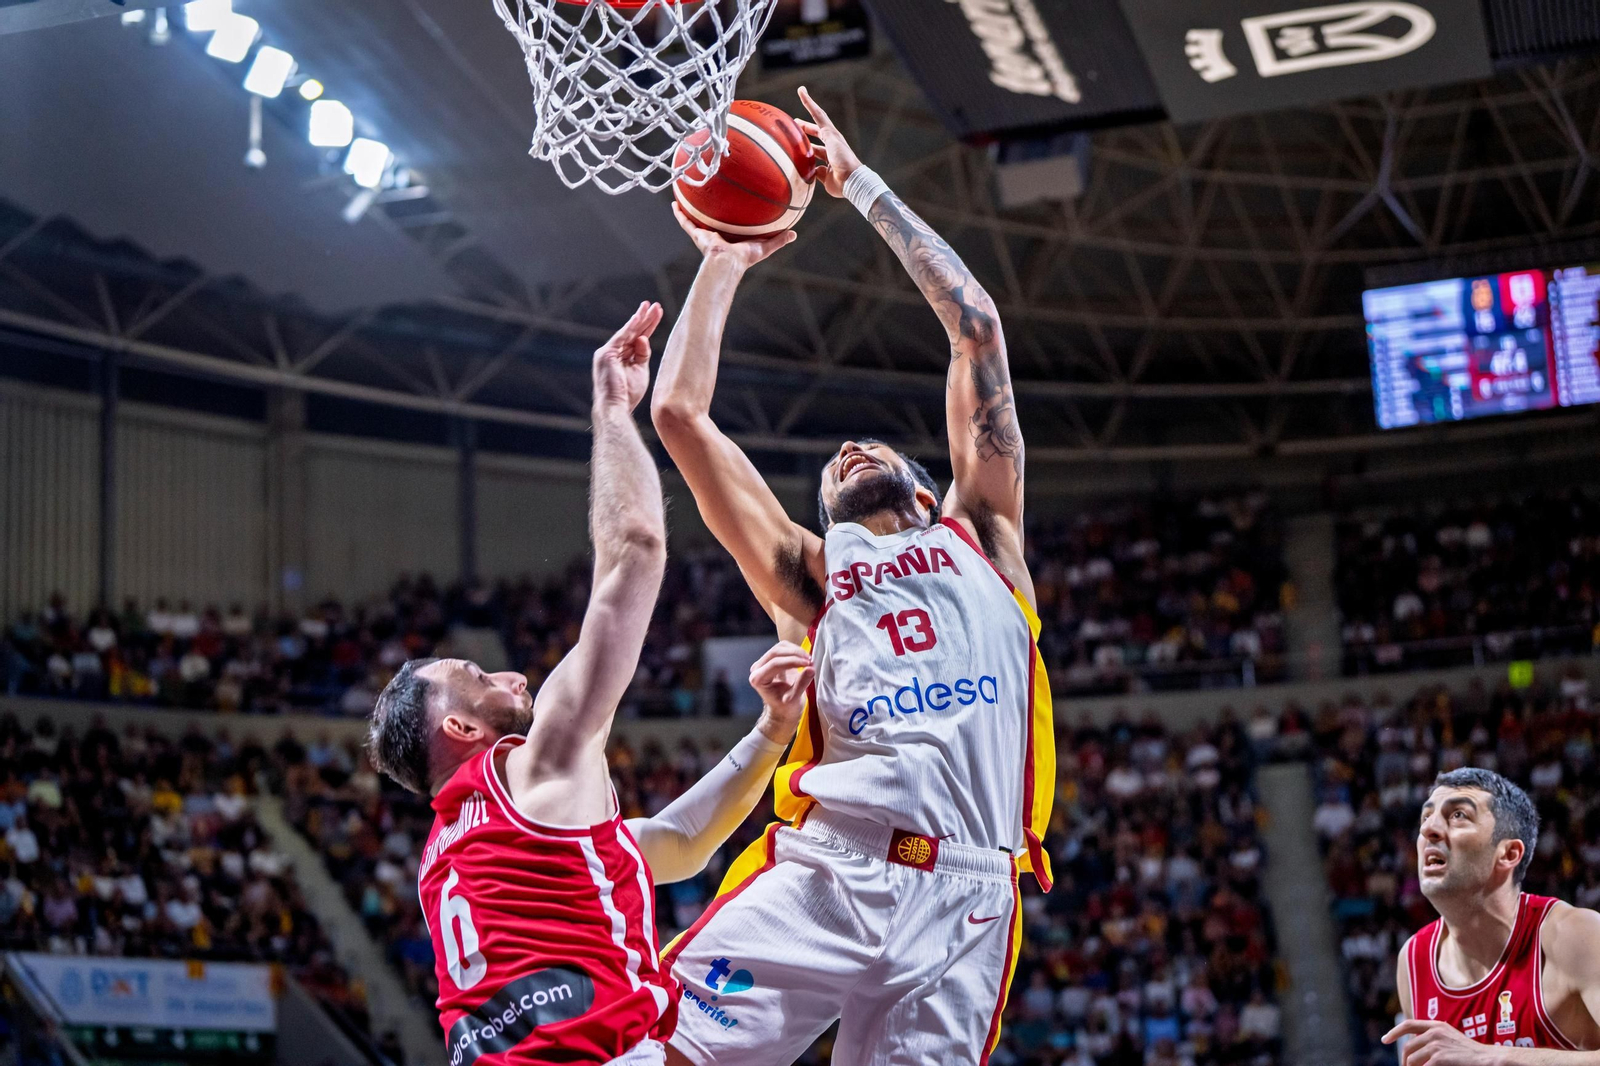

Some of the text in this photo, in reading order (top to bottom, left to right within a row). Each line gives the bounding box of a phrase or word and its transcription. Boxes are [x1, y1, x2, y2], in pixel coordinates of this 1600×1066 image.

[876, 608, 938, 657] 13
[848, 674, 999, 736] endesa
[440, 866, 488, 991] 6
